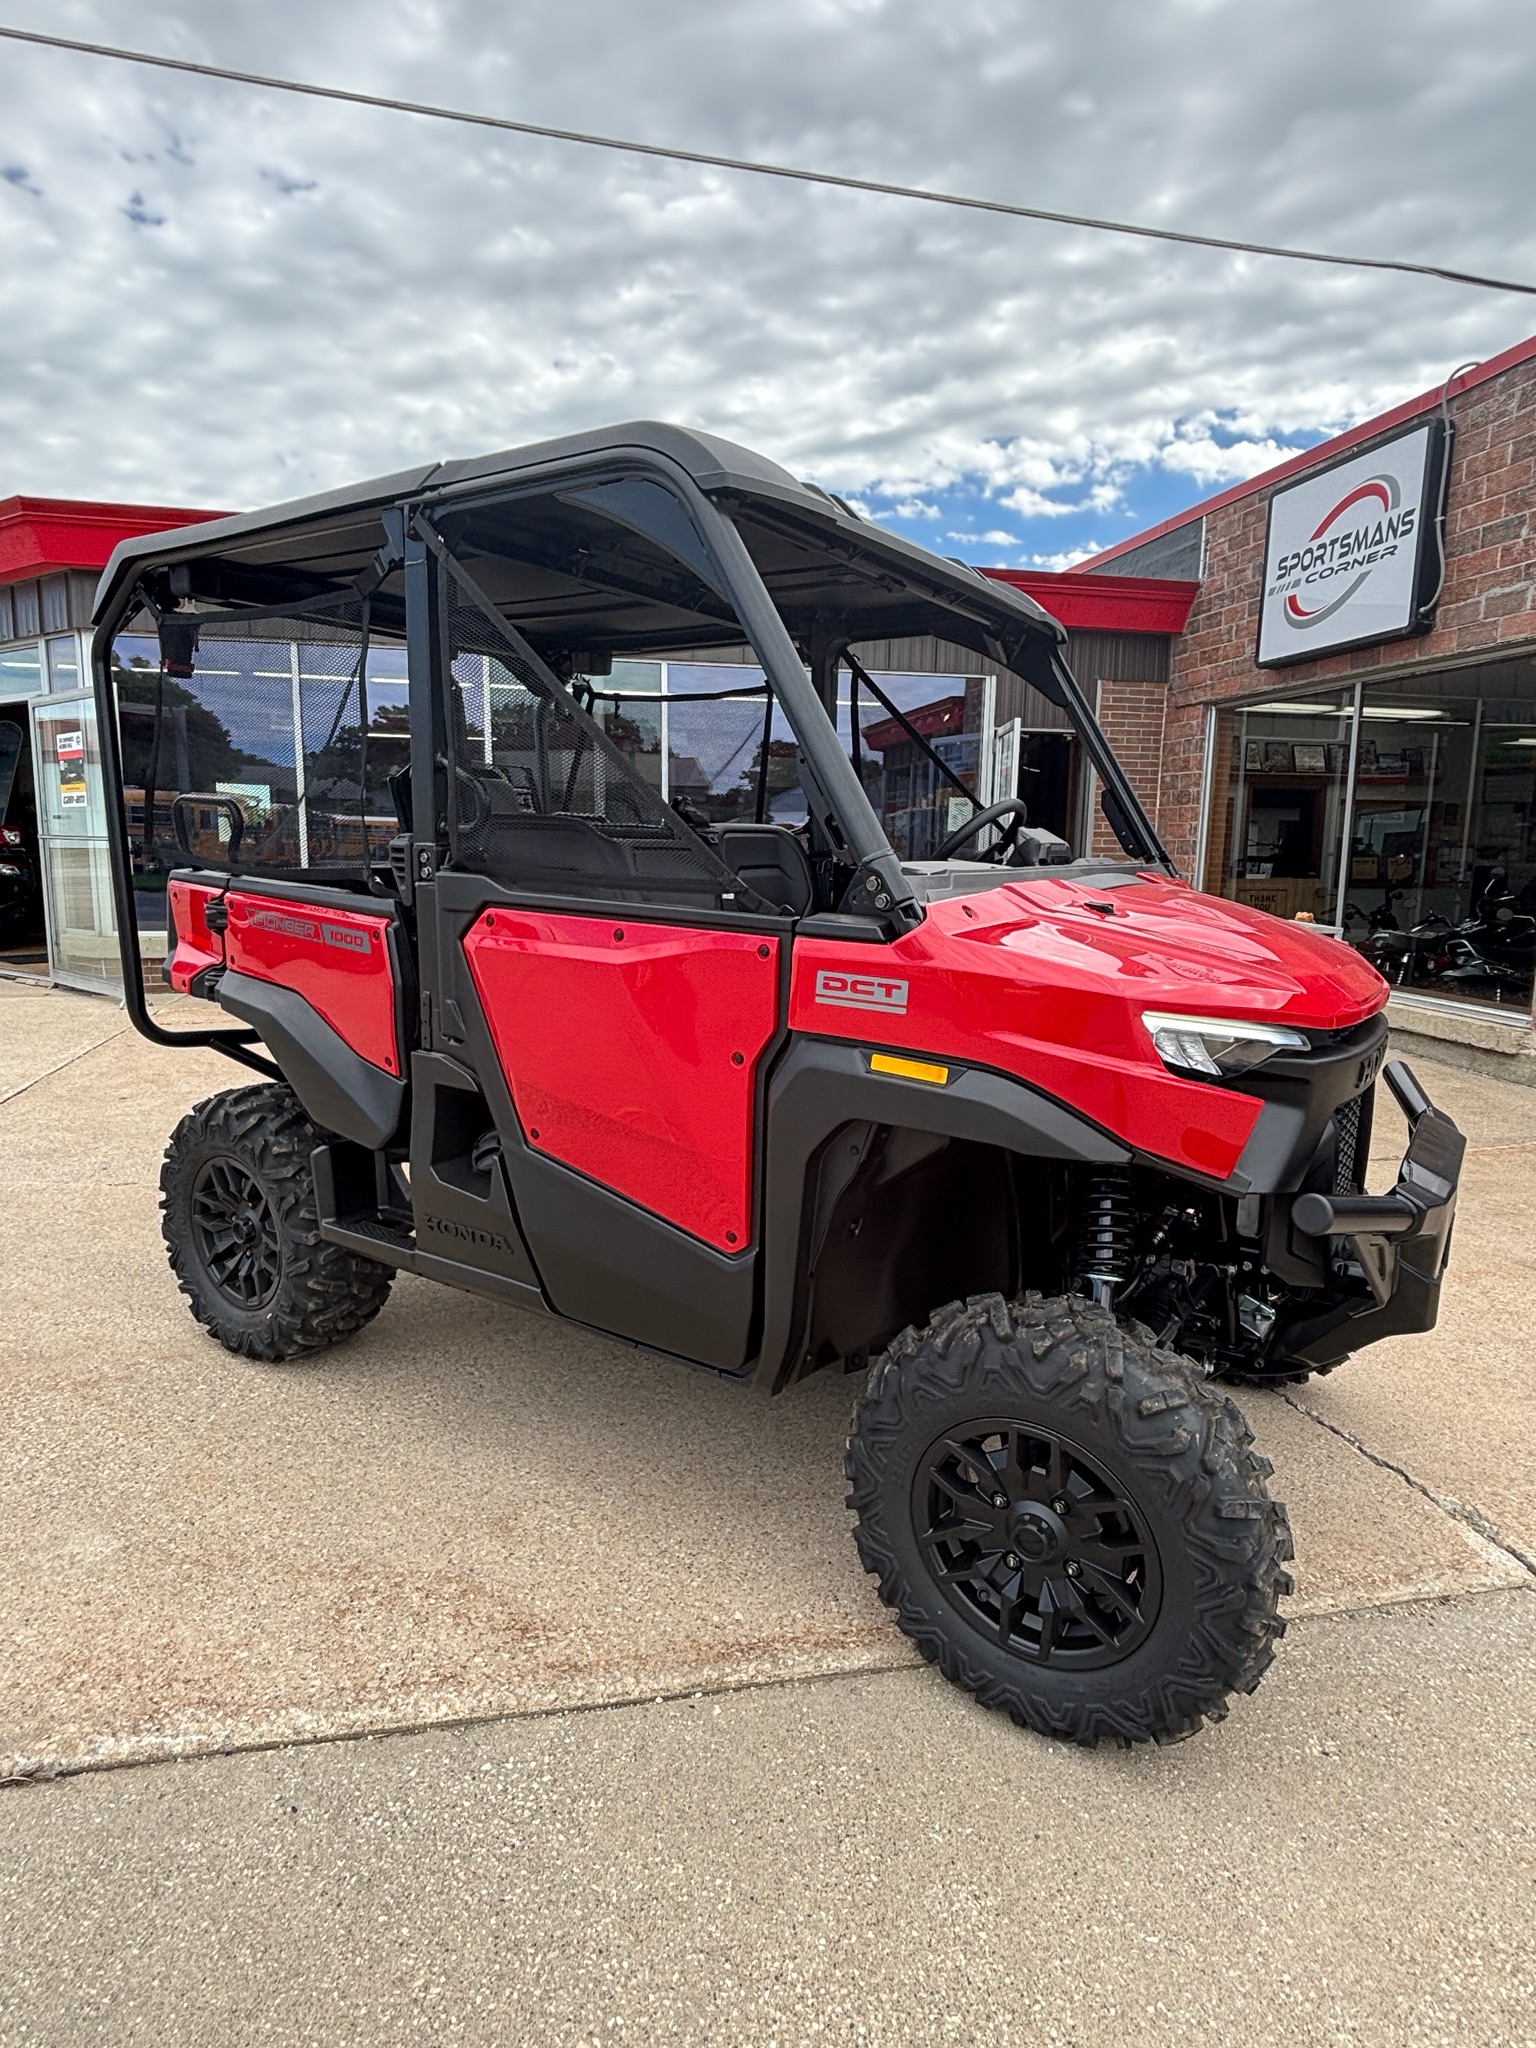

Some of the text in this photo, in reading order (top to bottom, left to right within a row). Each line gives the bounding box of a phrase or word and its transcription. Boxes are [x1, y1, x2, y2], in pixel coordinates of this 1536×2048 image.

[1275, 507, 1417, 582] SPORTSMANS
[1304, 544, 1399, 584] CORNER
[1249, 895, 1277, 903] THANK
[252, 912, 364, 946] PIONEER 1000
[822, 976, 902, 998] DCT
[425, 1212, 514, 1255] HONDA
